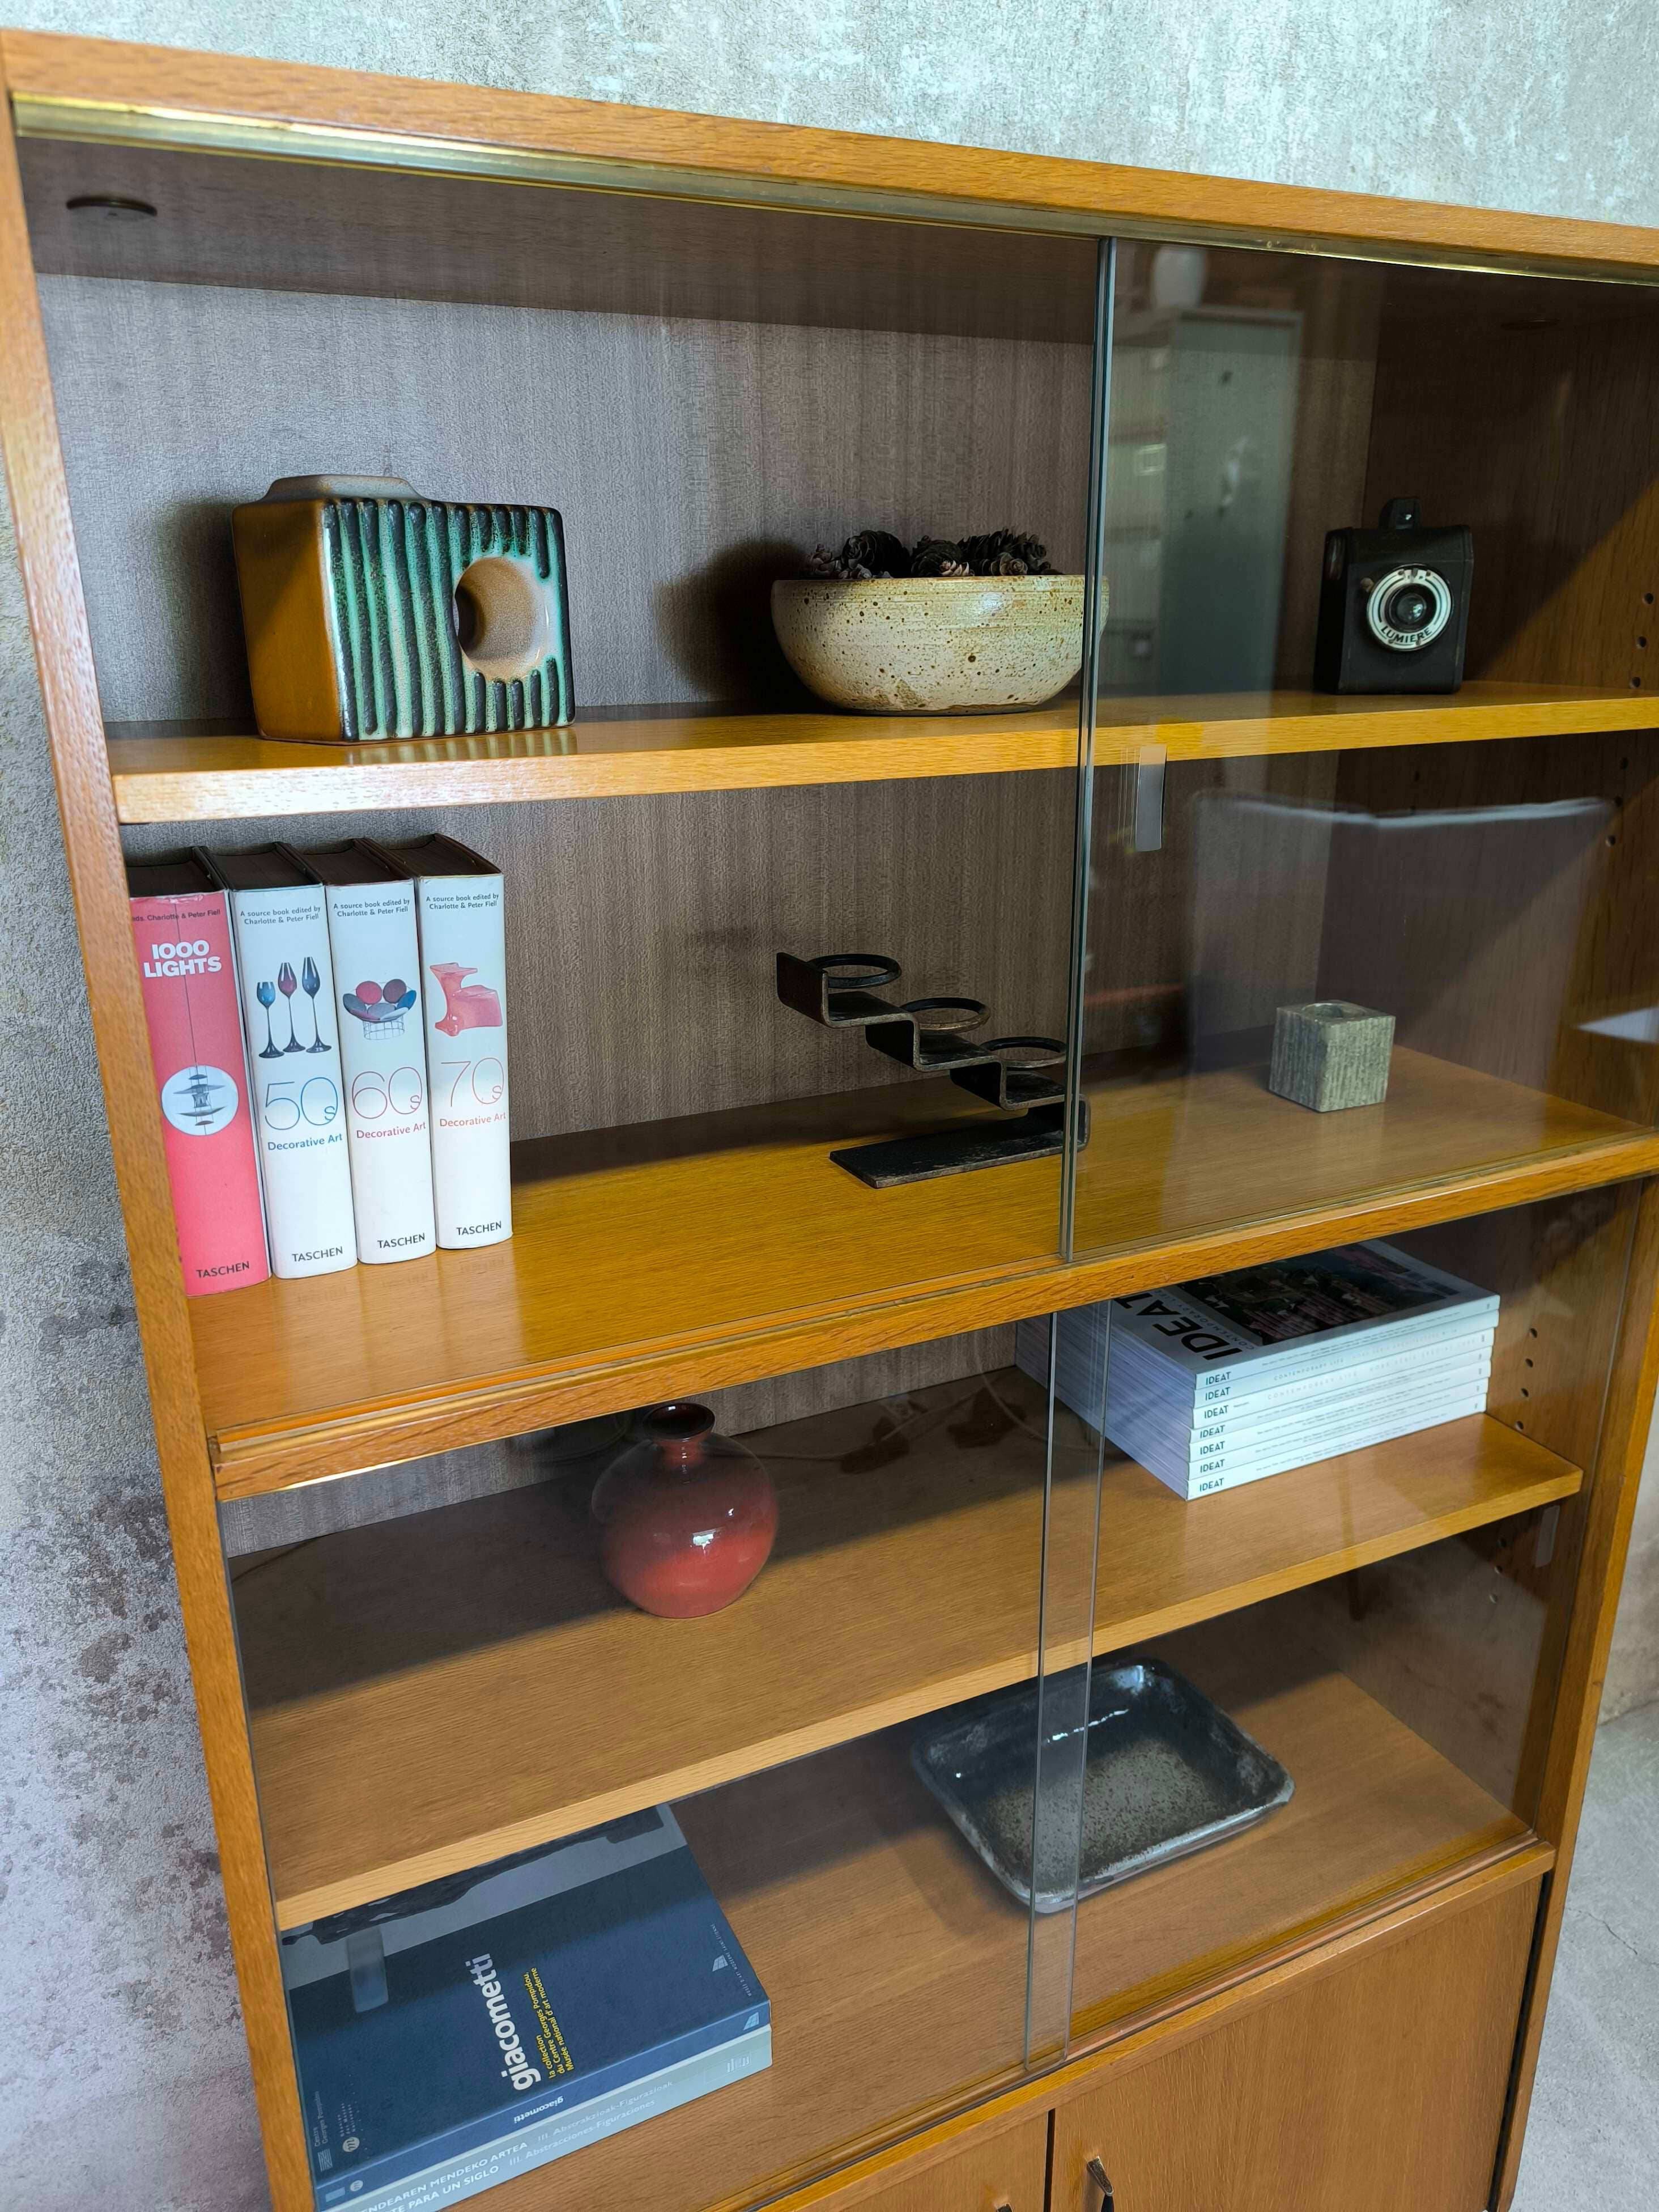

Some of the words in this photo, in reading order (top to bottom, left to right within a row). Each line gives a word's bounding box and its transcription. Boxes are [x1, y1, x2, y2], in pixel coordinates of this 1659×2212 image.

[1381, 626, 1432, 643] LUMIERE
[144, 956, 222, 977] LIGHTS
[440, 1116, 491, 1127] Decorative
[494, 1112, 506, 1122] Art
[356, 1126, 411, 1139] Decorative
[413, 1122, 426, 1132] Art
[267, 1137, 325, 1150] Decorative
[328, 1133, 342, 1143] Art
[457, 1221, 501, 1236] TASCHEN
[377, 1233, 425, 1248] TASCHEN
[292, 1246, 343, 1262] TASCHEN
[196, 1261, 250, 1278] TASCHEN
[1114, 1292, 1243, 1360] IDEAT
[1206, 1372, 1231, 1385] IDEAT
[1205, 1387, 1231, 1400] IDEAT
[1205, 1405, 1229, 1419] IDEAT
[1200, 1425, 1225, 1438] IDEAT
[1200, 1441, 1225, 1455] IDEAT
[1200, 1459, 1225, 1472] IDEAT
[1199, 1478, 1224, 1492] IDEAT
[524, 1972, 541, 2009] Pompidou,
[531, 1967, 547, 1999] moderne
[542, 1999, 554, 2016] d'art
[465, 1954, 541, 2090] giacometti
[537, 2009, 551, 2039] Georges
[548, 2017, 564, 2045] national
[536, 2035, 553, 2069] collection
[548, 2039, 560, 2064] Centre
[561, 2046, 574, 2071] Musée
[548, 2070, 556, 2079] la
[557, 2064, 565, 2074] du
[514, 2096, 564, 2124] giacometti
[430, 2159, 488, 2188] MENDEKO
[490, 2142, 528, 2163] ARTEA
[409, 2191, 440, 2209] PARA
[443, 2182, 462, 2194] UN
[464, 2166, 499, 2185] SIGLO
